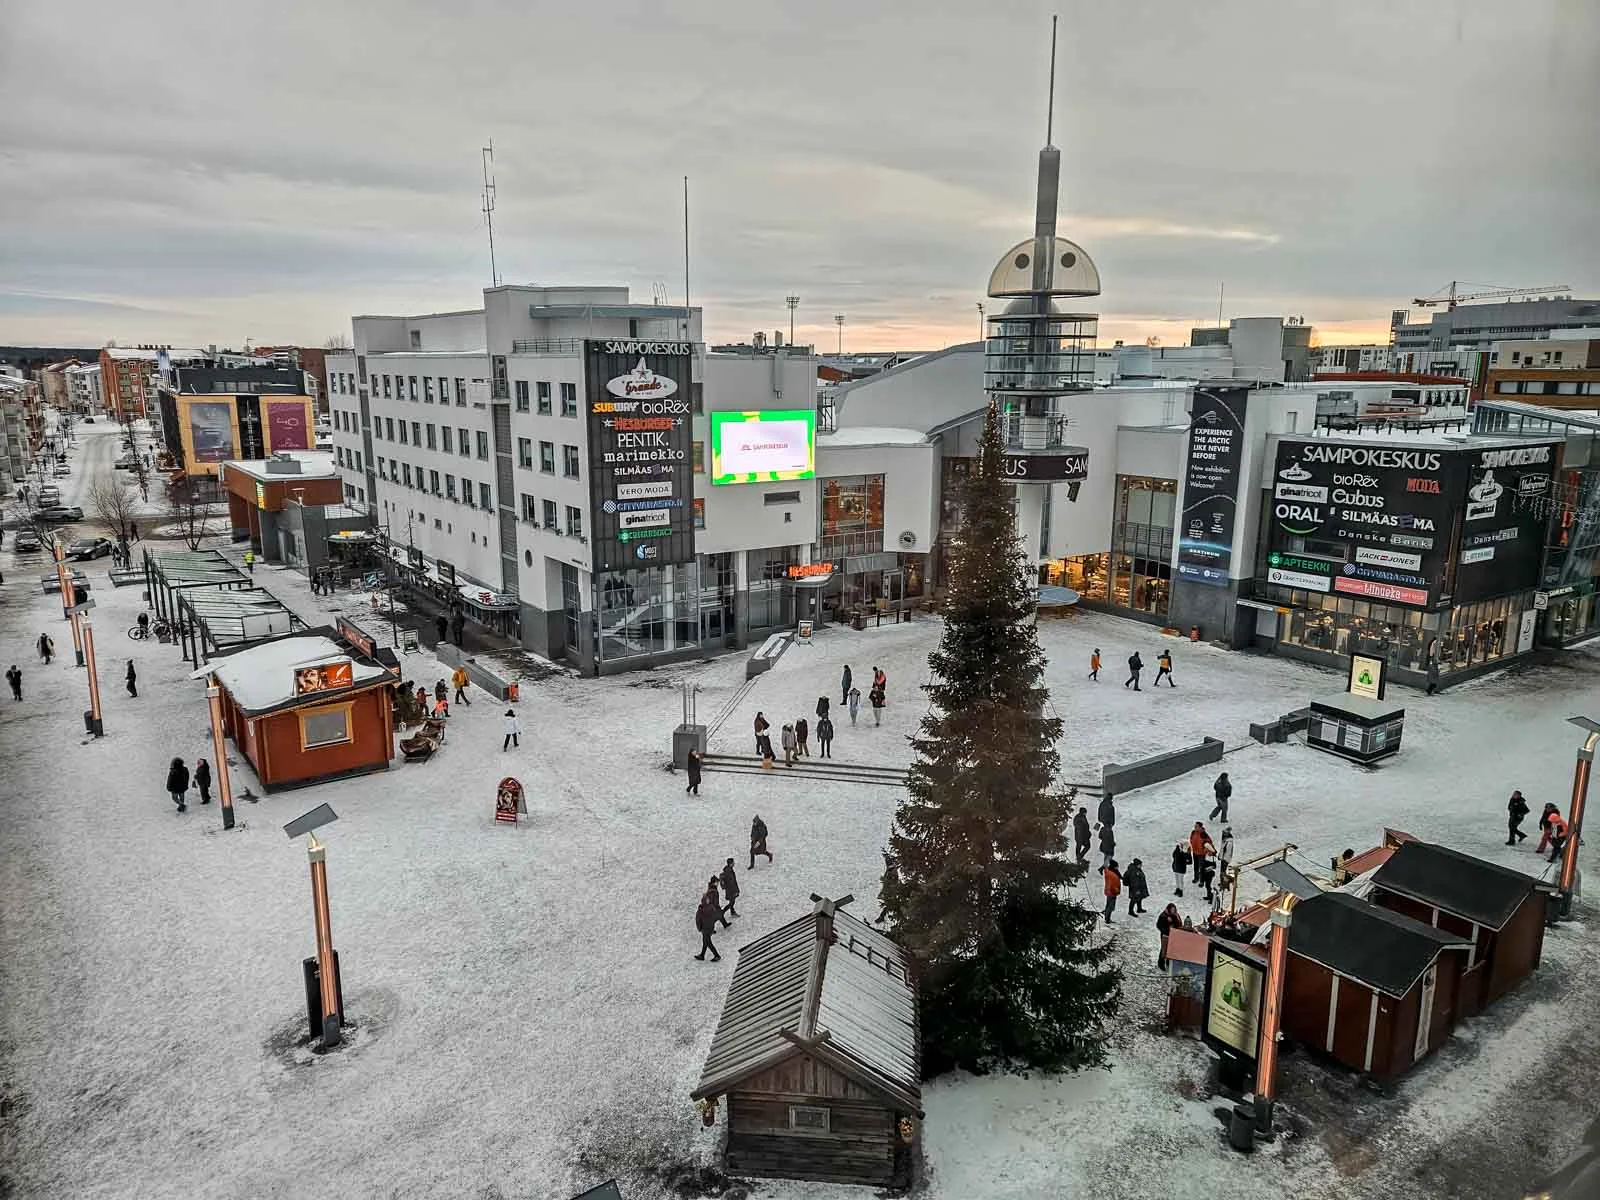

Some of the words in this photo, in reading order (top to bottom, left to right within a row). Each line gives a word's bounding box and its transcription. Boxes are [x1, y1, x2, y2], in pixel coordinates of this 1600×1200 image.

[605, 341, 690, 355] SAMPOKESKUS
[592, 401, 639, 413] SUBWAY
[1195, 428, 1233, 437] EXPERIENCE
[1207, 437, 1230, 445] ARCTIC
[604, 448, 685, 463] marimekko
[1208, 445, 1230, 453] NEVER
[1302, 445, 1441, 471] SAMPOKESKUS
[645, 486, 669, 494] MODA
[1275, 503, 1325, 523] ORAL
[1283, 557, 1330, 573] APTEEKKI
[1359, 552, 1381, 561] JACK
[1388, 557, 1416, 566] JONES
